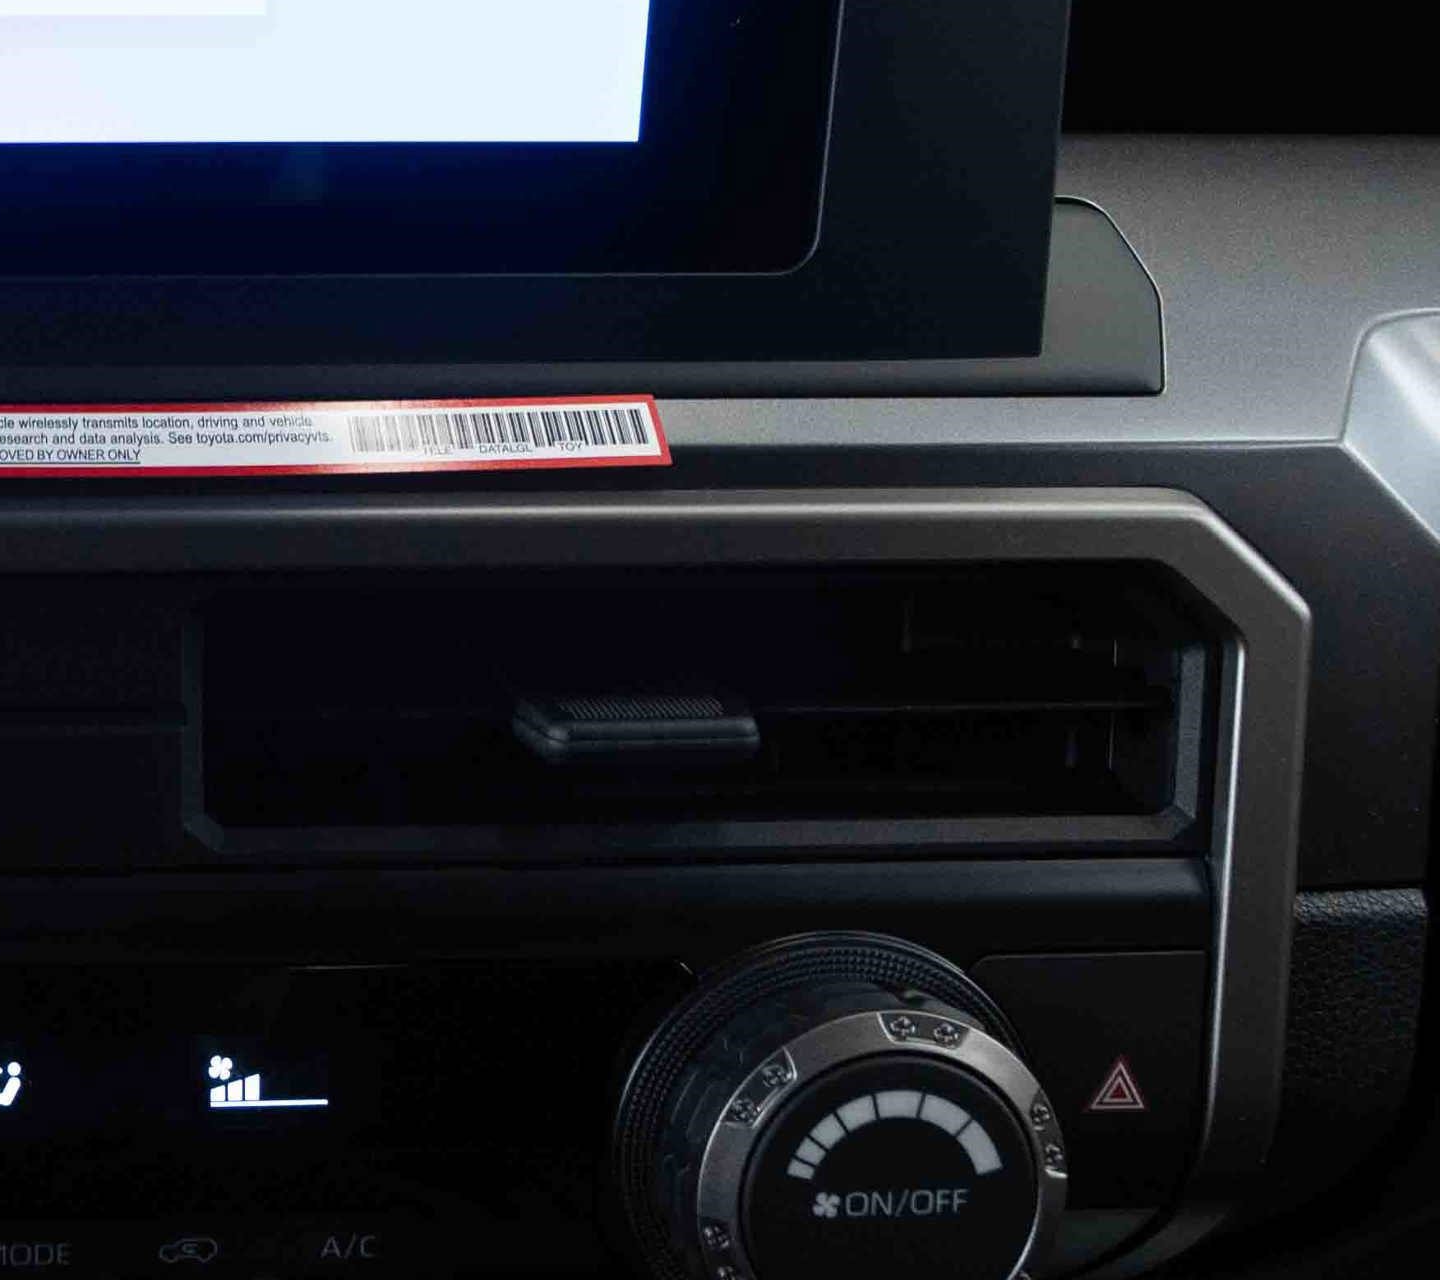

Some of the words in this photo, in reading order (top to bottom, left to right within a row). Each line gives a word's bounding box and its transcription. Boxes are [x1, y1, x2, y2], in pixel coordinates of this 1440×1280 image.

[19, 417, 78, 432] wirelessly
[83, 417, 138, 429] transmits
[142, 416, 193, 431] location,
[198, 416, 238, 432] driving
[242, 416, 265, 428] and
[269, 416, 313, 428] vehicle
[52, 431, 75, 444] and
[79, 431, 106, 444] data
[110, 431, 164, 446] analysis.
[168, 431, 193, 443] See
[37, 449, 54, 460] BY
[57, 449, 105, 460] OWNER
[108, 449, 141, 460] ONLY
[844, 1187, 969, 1220] ON/OFF
[320, 1234, 380, 1262] A/C
